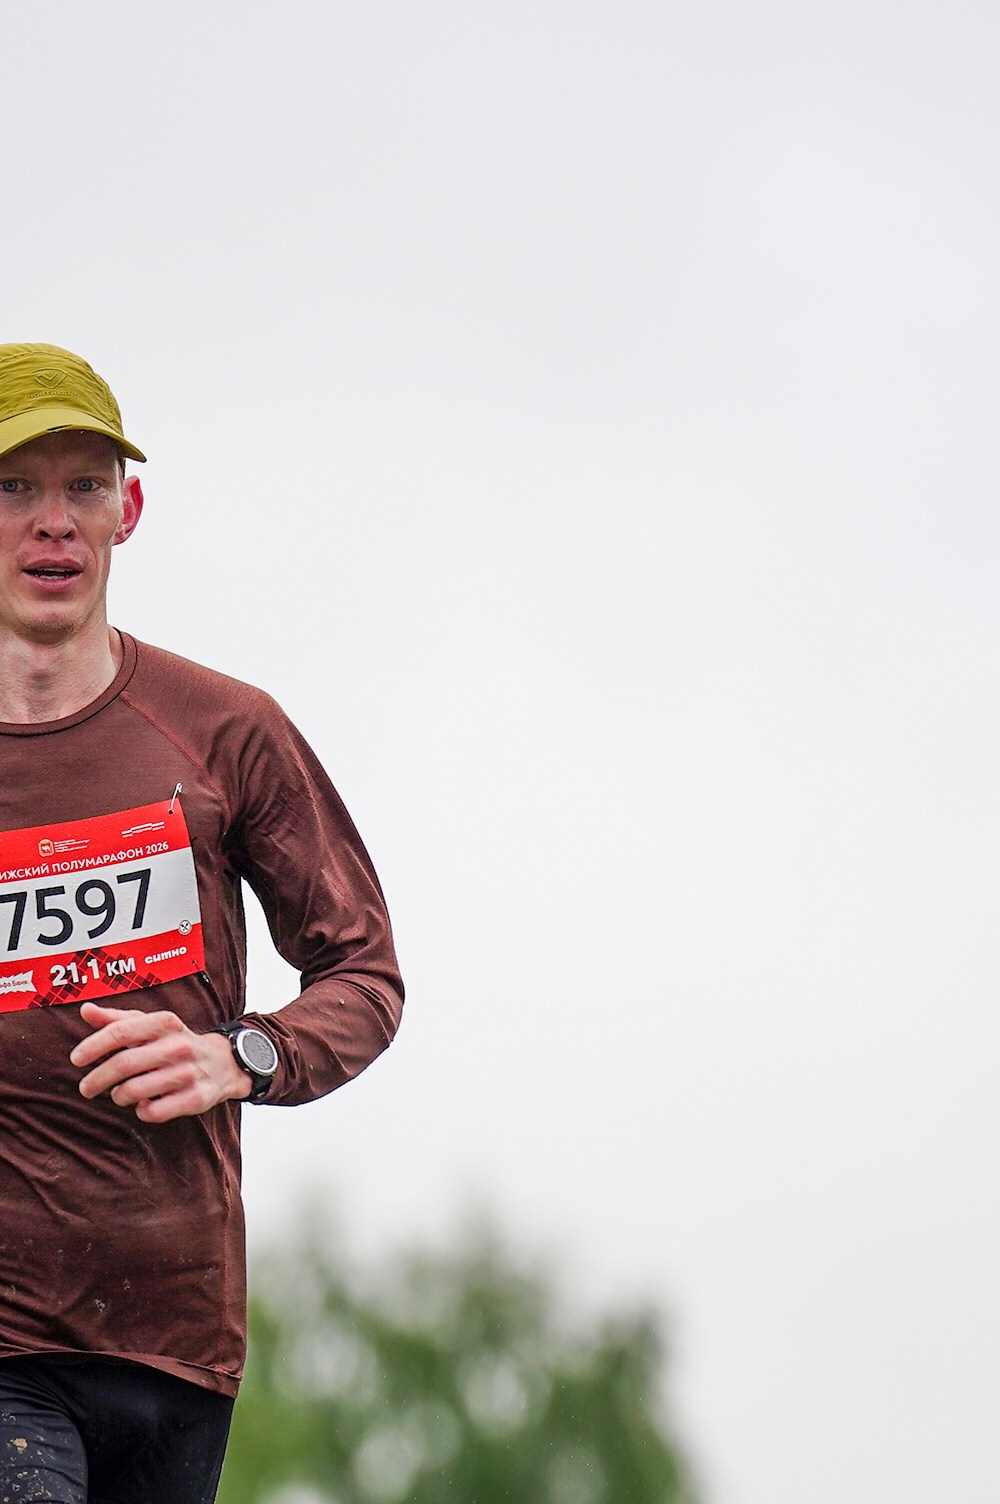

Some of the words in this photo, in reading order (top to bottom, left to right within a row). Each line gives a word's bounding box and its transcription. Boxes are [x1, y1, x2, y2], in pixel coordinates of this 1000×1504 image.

[52, 849, 143, 872] ПОЛУМАРАФОН
[146, 841, 169, 854] 2026
[50, 958, 100, 987] 21,1
